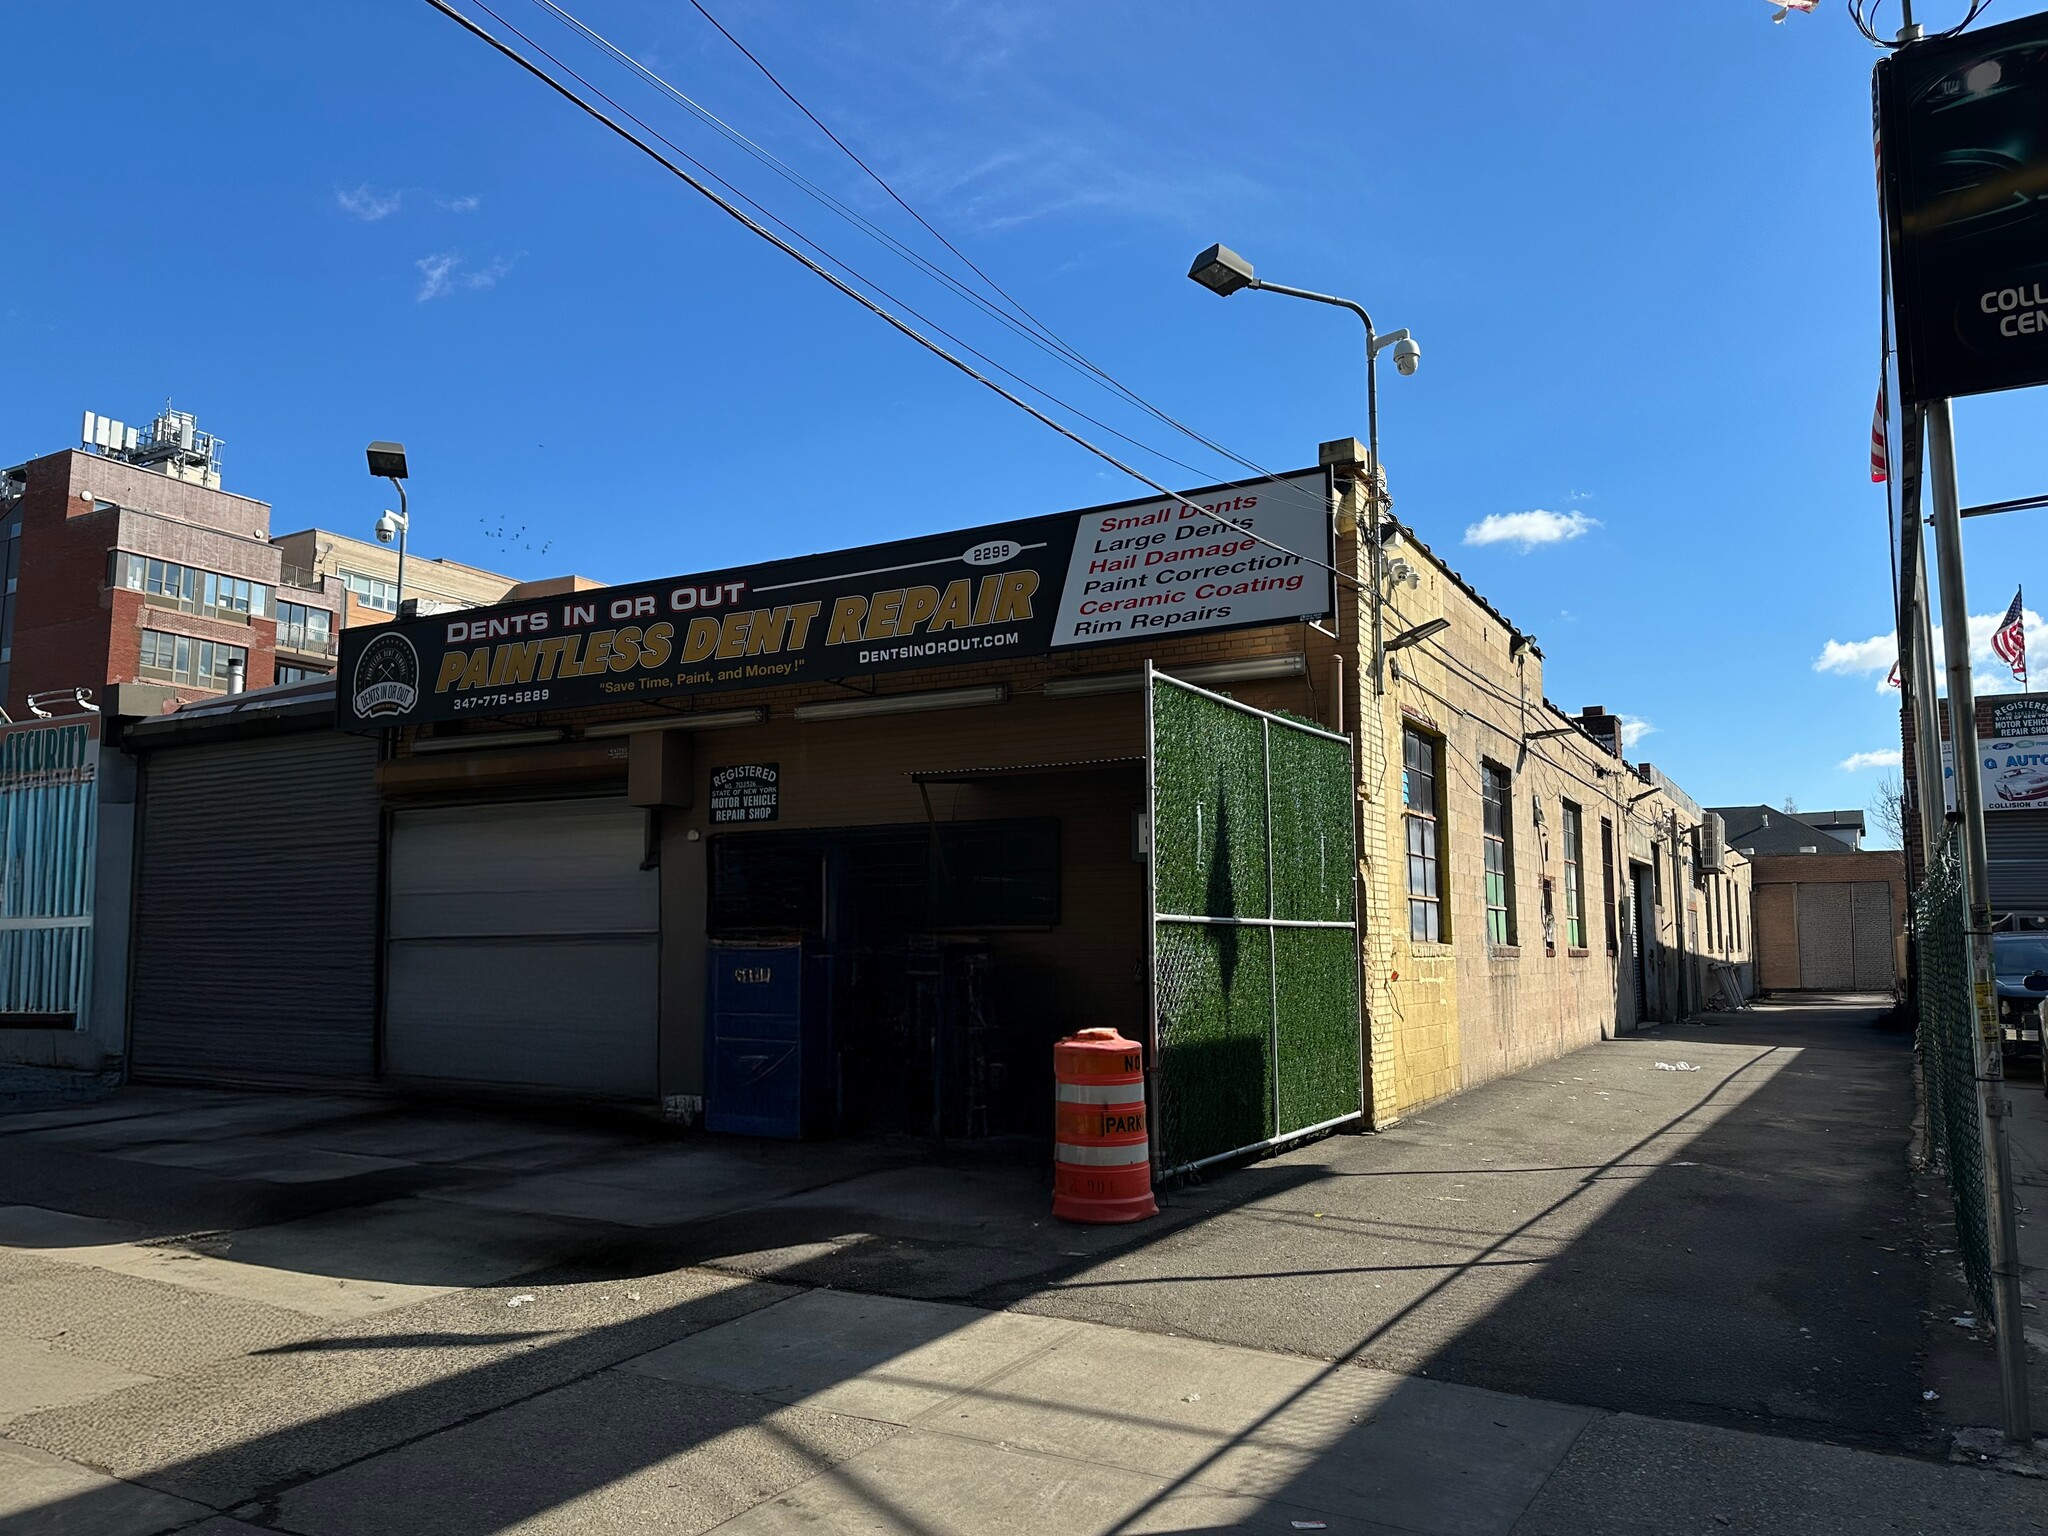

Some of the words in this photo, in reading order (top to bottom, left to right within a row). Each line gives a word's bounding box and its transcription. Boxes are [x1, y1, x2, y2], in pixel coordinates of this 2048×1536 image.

[1980, 283, 2048, 314] COLL
[1100, 508, 1171, 533] Small
[1178, 496, 1258, 520] Dents
[1094, 531, 1167, 554] Large
[1174, 516, 1254, 541] Dents
[973, 544, 1010, 562] 2299
[1088, 553, 1137, 575] Hail
[1144, 538, 1256, 568] Damage
[1083, 573, 1149, 596] Paint
[1155, 554, 1304, 584] Correction
[1079, 590, 1187, 616] Ceramic
[1195, 574, 1304, 600] Coating
[446, 611, 549, 644] DENTS
[563, 604, 596, 627] IN
[609, 596, 656, 620] OR
[670, 580, 747, 611] OUT
[1073, 619, 1121, 637] Rim
[1130, 604, 1232, 629] Repairs
[435, 621, 675, 694] PAINTLESS
[681, 600, 822, 665] DENT
[825, 569, 1040, 646] REPAIR
[859, 632, 1019, 664] DENTSINOROUT.COM
[600, 680, 636, 694] "Save
[638, 676, 674, 690] Time,
[677, 670, 713, 685] Paint,
[717, 666, 743, 680] and
[360, 686, 380, 708] DENTS
[382, 685, 387, 699] IN
[388, 685, 396, 699] OR
[397, 686, 411, 703] OUT
[453, 689, 551, 710] 347-776-5289
[1995, 720, 2021, 729] MOTOR
[2001, 727, 2029, 737] REPAIR
[4, 722, 91, 783] SECURITY
[713, 765, 777, 787] REGISTERED
[711, 797, 739, 809] MOTOR
[743, 793, 777, 807] VEHICLE
[716, 809, 745, 821] REPAIR
[748, 807, 772, 820] SHOP
[1988, 801, 2031, 809] COLLISION
